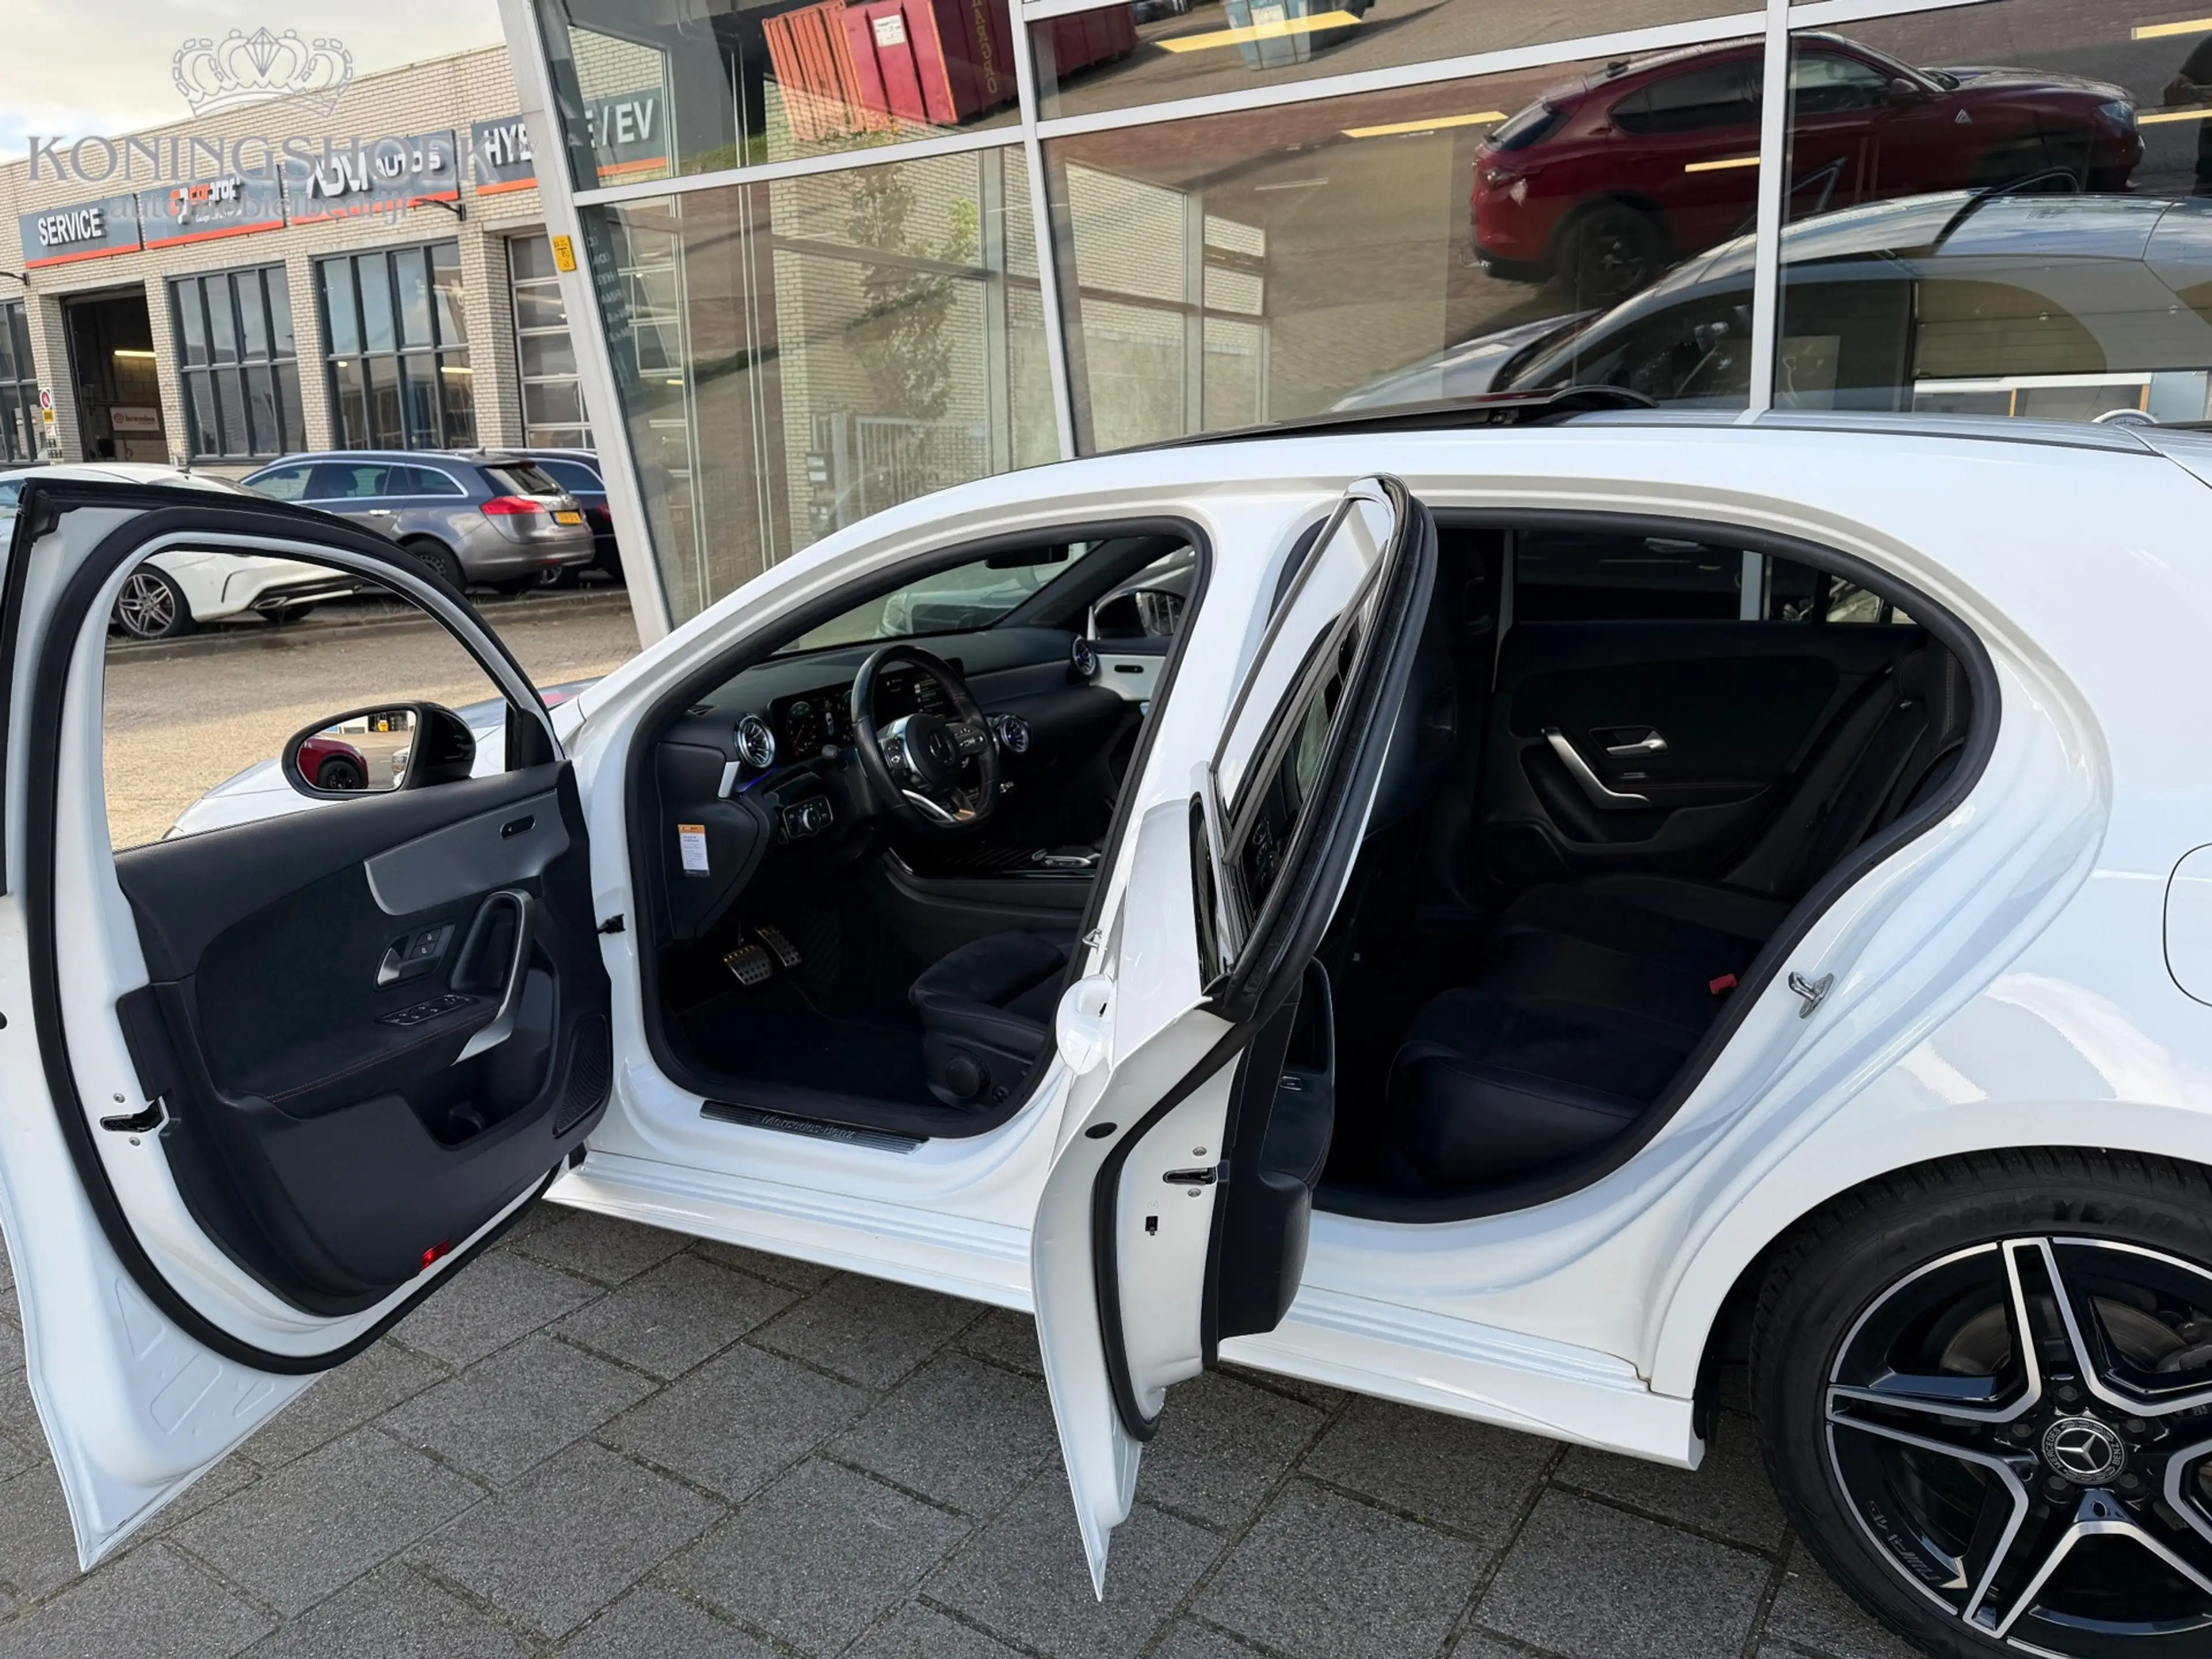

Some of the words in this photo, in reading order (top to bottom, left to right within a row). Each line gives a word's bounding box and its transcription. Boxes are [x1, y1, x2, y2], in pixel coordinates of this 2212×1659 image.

[37, 207, 102, 247] SERVICE
[762, 1114, 857, 1139] Mercedes-Benz
[2046, 1426, 2063, 1469] MERCEDES
[2110, 1442, 2122, 1467] BENZ
